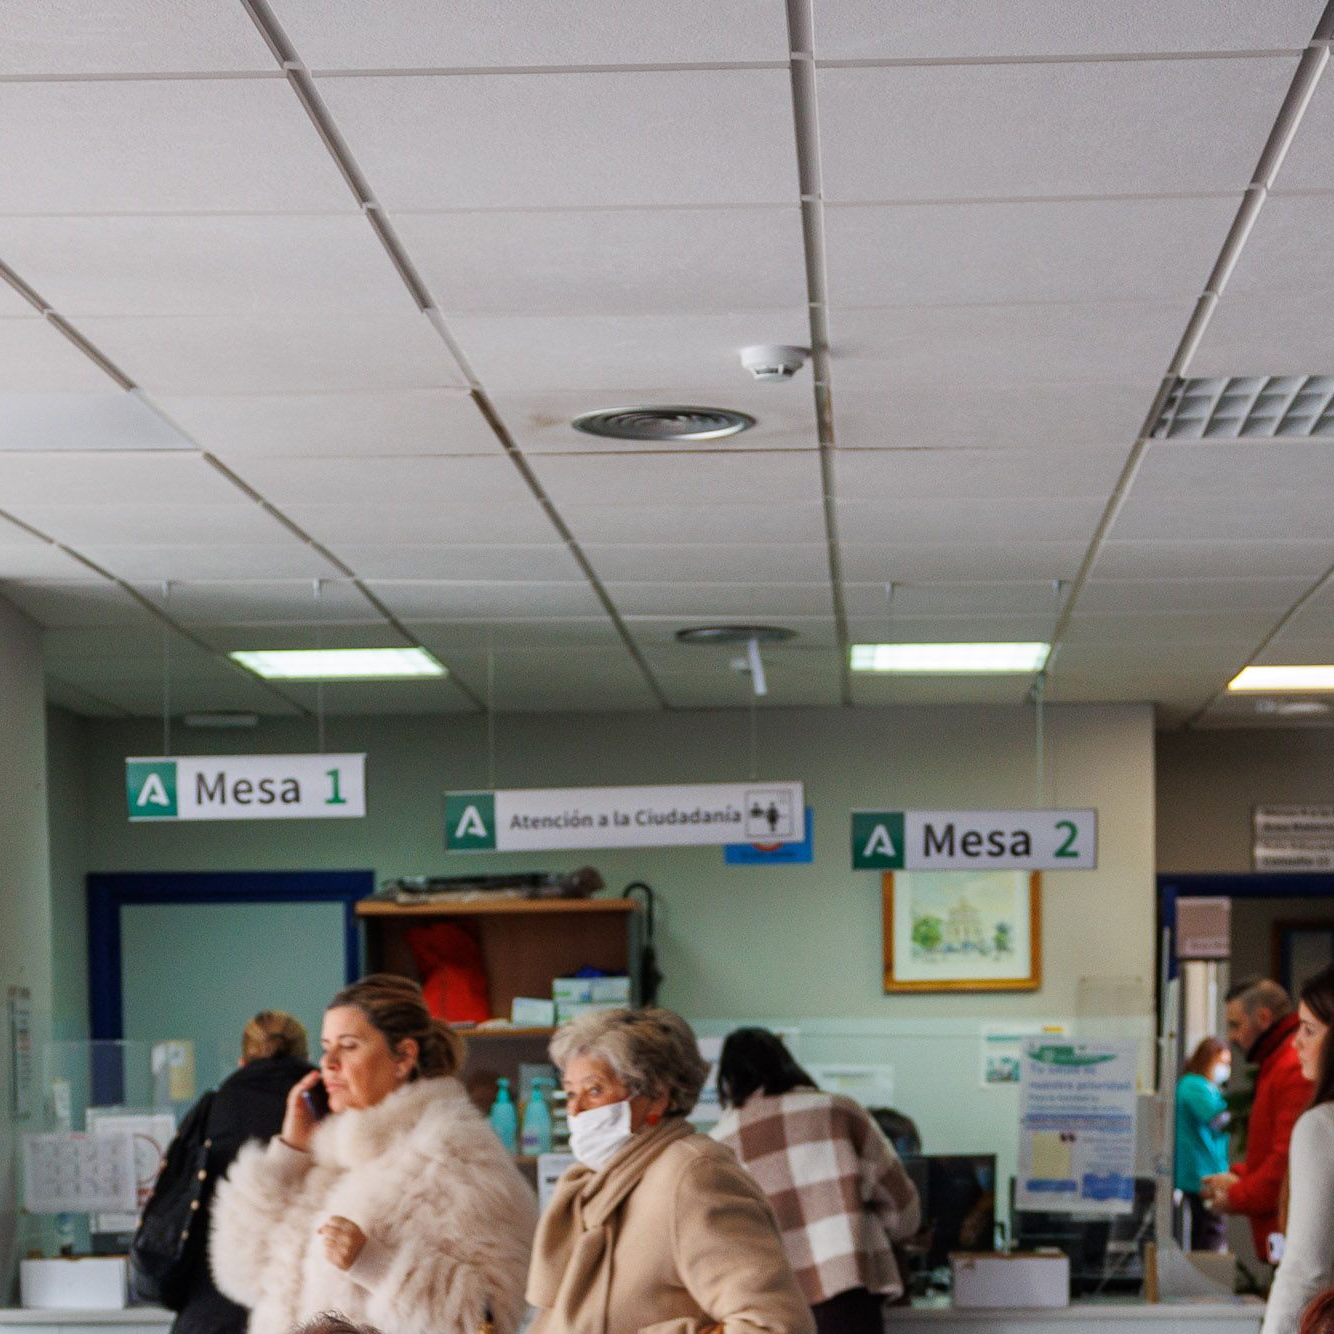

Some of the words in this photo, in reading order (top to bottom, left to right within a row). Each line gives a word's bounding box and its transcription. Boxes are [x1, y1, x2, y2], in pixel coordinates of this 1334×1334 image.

[196, 771, 301, 806] Mesa
[324, 768, 347, 804] 1
[510, 809, 593, 830] Atención
[598, 815, 609, 828] a
[613, 810, 630, 827] la
[635, 803, 743, 827] Ciudadanía
[923, 823, 1031, 858] Mesa
[1054, 819, 1079, 859] 2
